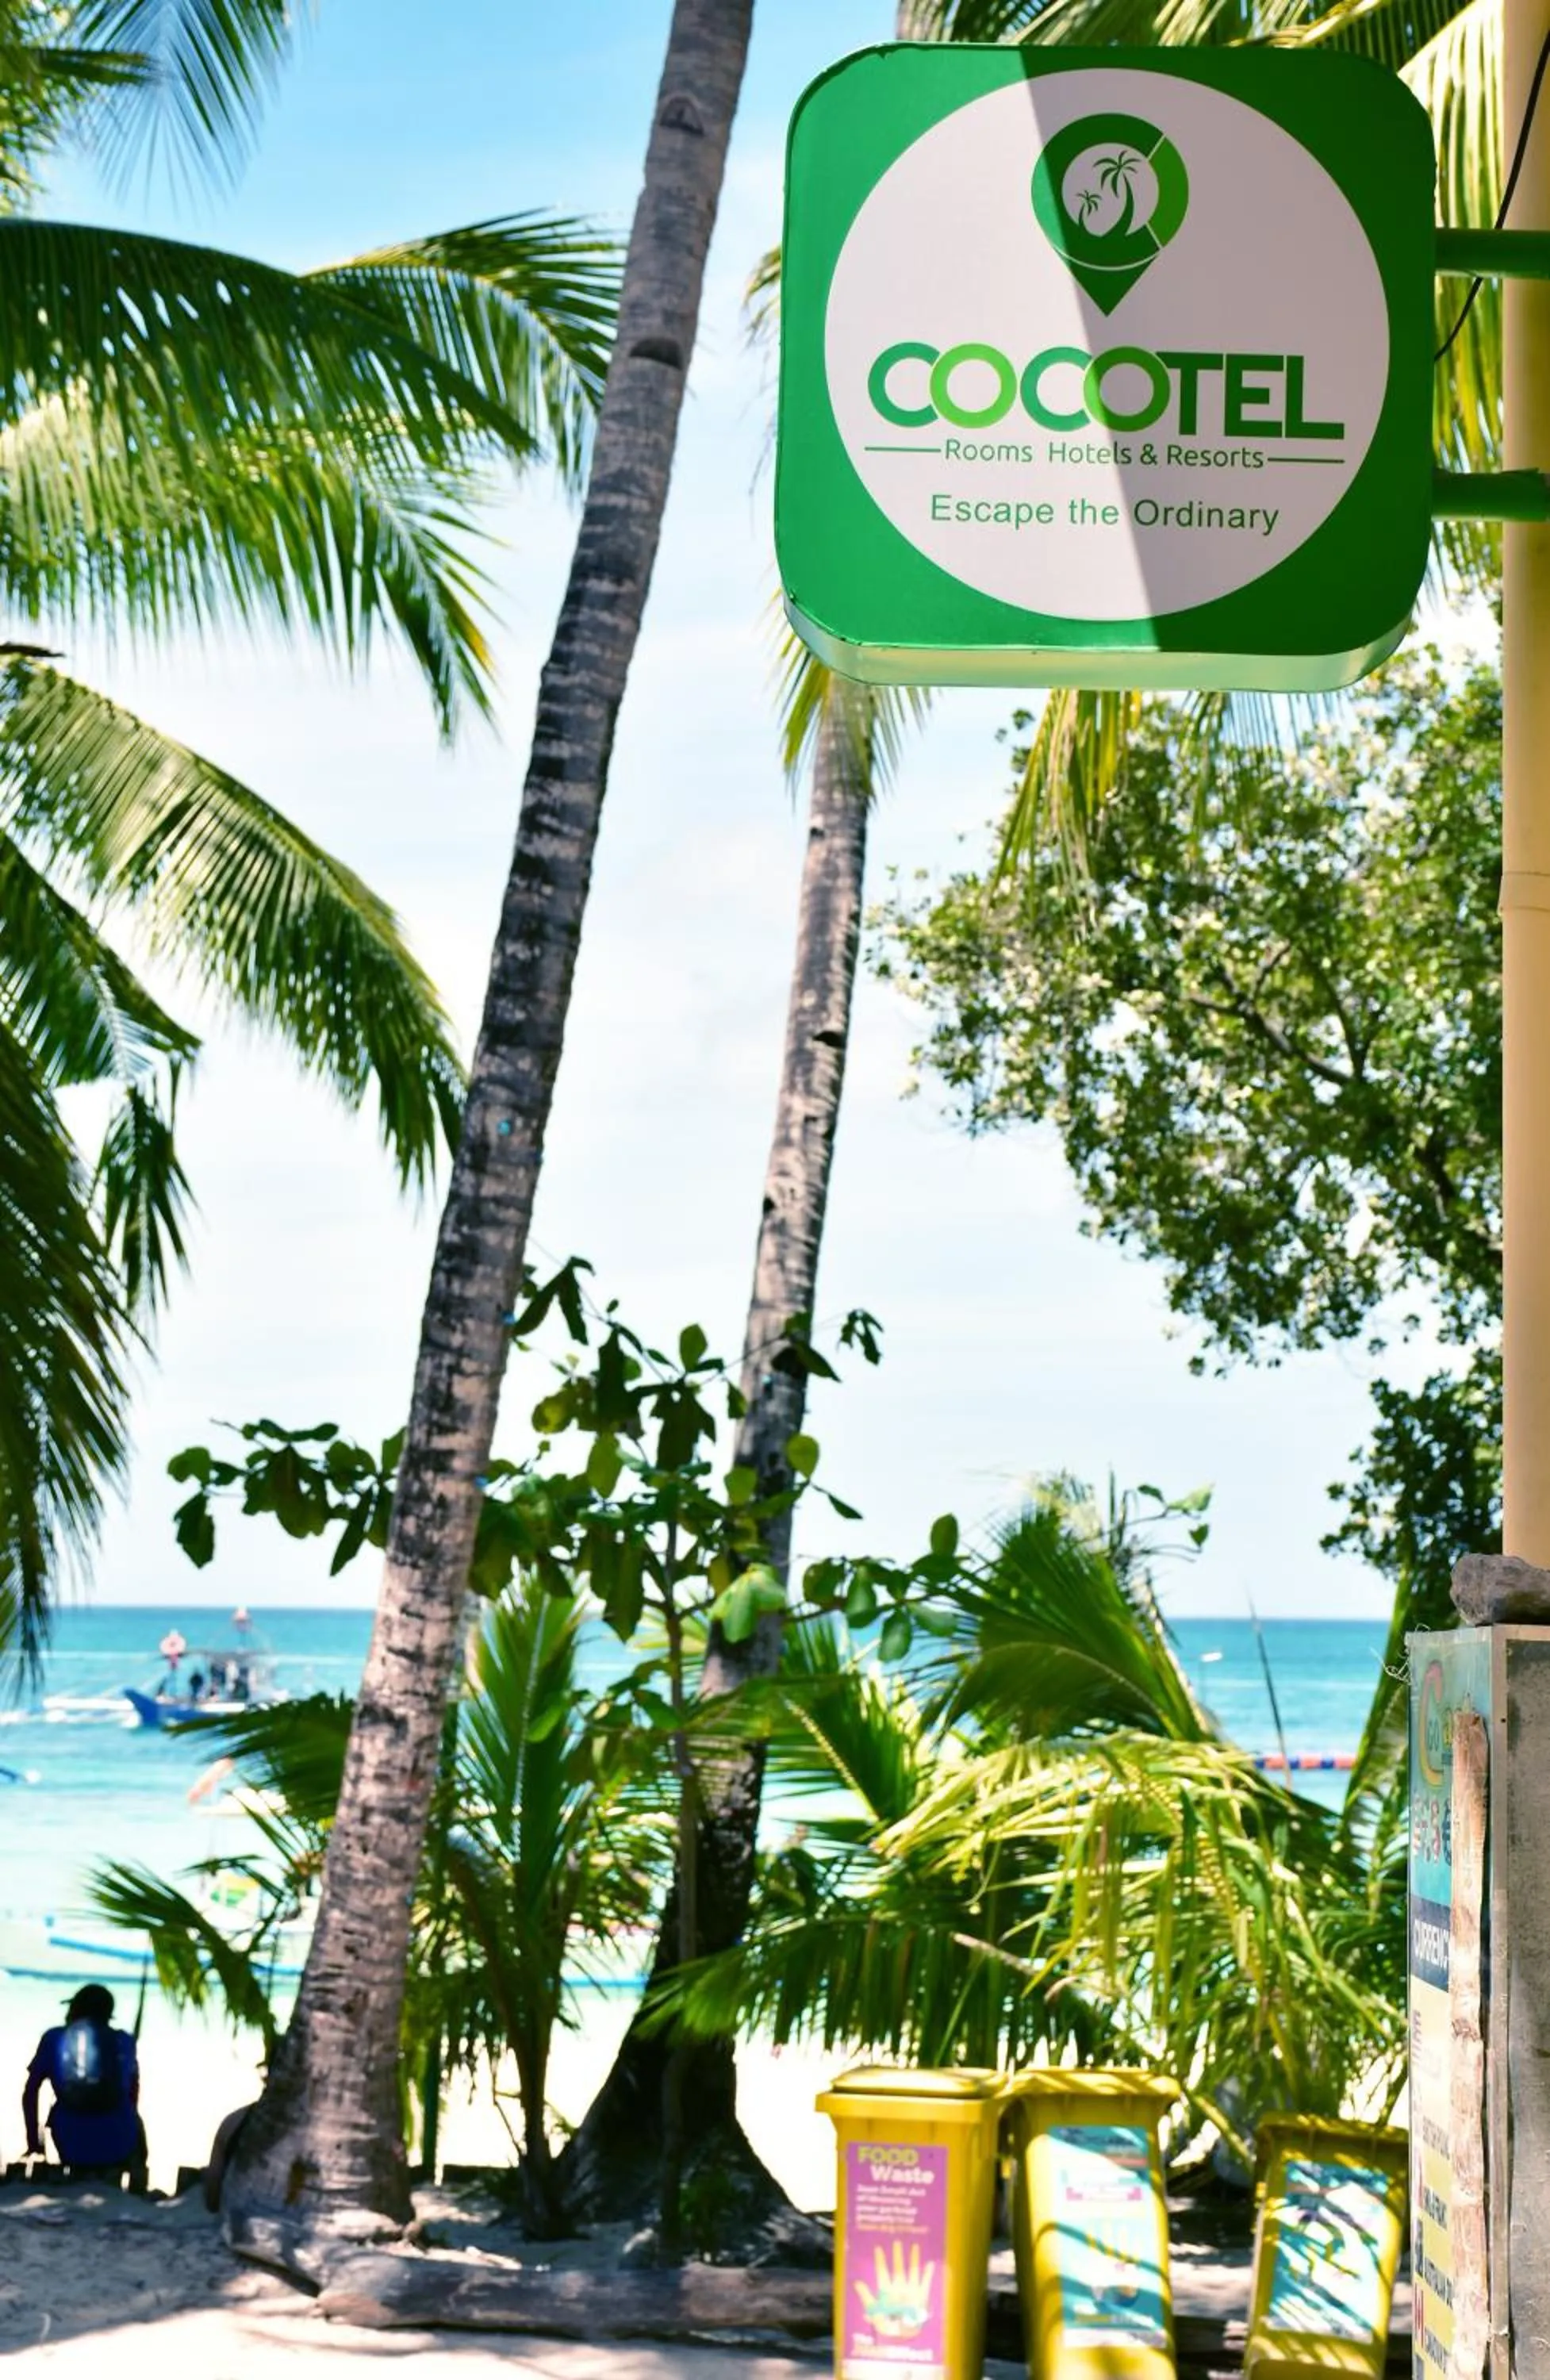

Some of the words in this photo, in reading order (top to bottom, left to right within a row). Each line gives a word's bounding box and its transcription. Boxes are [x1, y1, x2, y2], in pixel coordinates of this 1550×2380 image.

[867, 342, 1345, 440] COCOTEL
[945, 439, 1033, 463] Rooms
[1049, 440, 1132, 466] Hotels
[1140, 445, 1157, 465] &
[1168, 444, 1264, 469] Resorts
[931, 493, 1054, 530] Escape
[1069, 497, 1120, 525] the
[1134, 498, 1280, 536] Ordinary
[1413, 1917, 1450, 1969] CURRENC
[857, 2146, 919, 2166] FOOD
[870, 2164, 935, 2185] Waste
